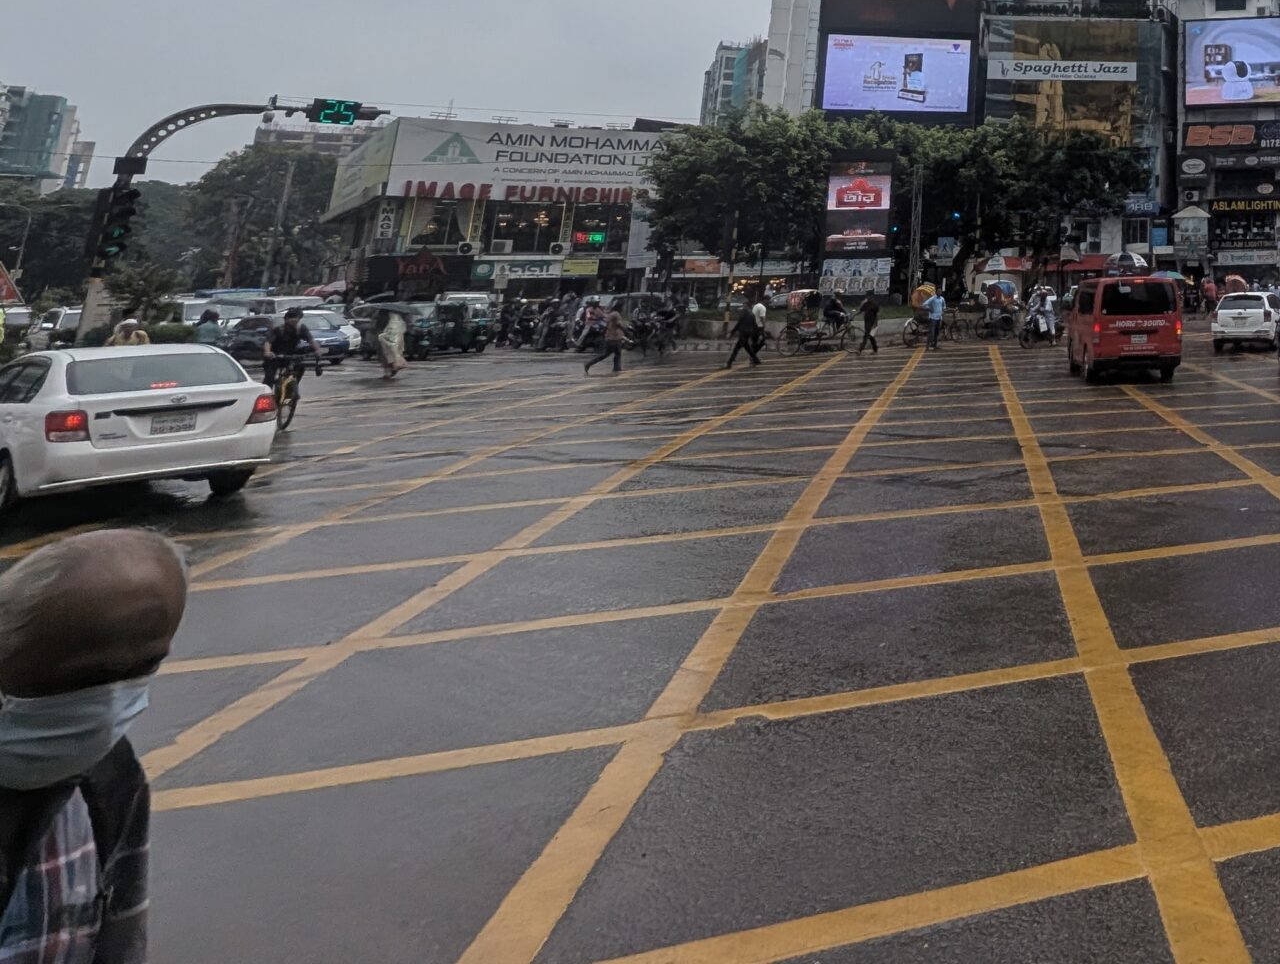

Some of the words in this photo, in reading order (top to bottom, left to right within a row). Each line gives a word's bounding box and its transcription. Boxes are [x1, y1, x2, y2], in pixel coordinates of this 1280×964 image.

[1012, 62, 1089, 76] Spaghetti
[1093, 63, 1129, 74] Jazz
[320, 99, 356, 125] 25
[486, 132, 545, 148] AMIN
[549, 135, 666, 152] MOHAMMA
[1185, 124, 1256, 147] BSB
[495, 150, 626, 166] FOUNDATION
[631, 155, 653, 167] LT
[404, 180, 493, 201] IMAGE
[1212, 200, 1245, 211] ASLAM
[380, 199, 395, 238] IMAGE
